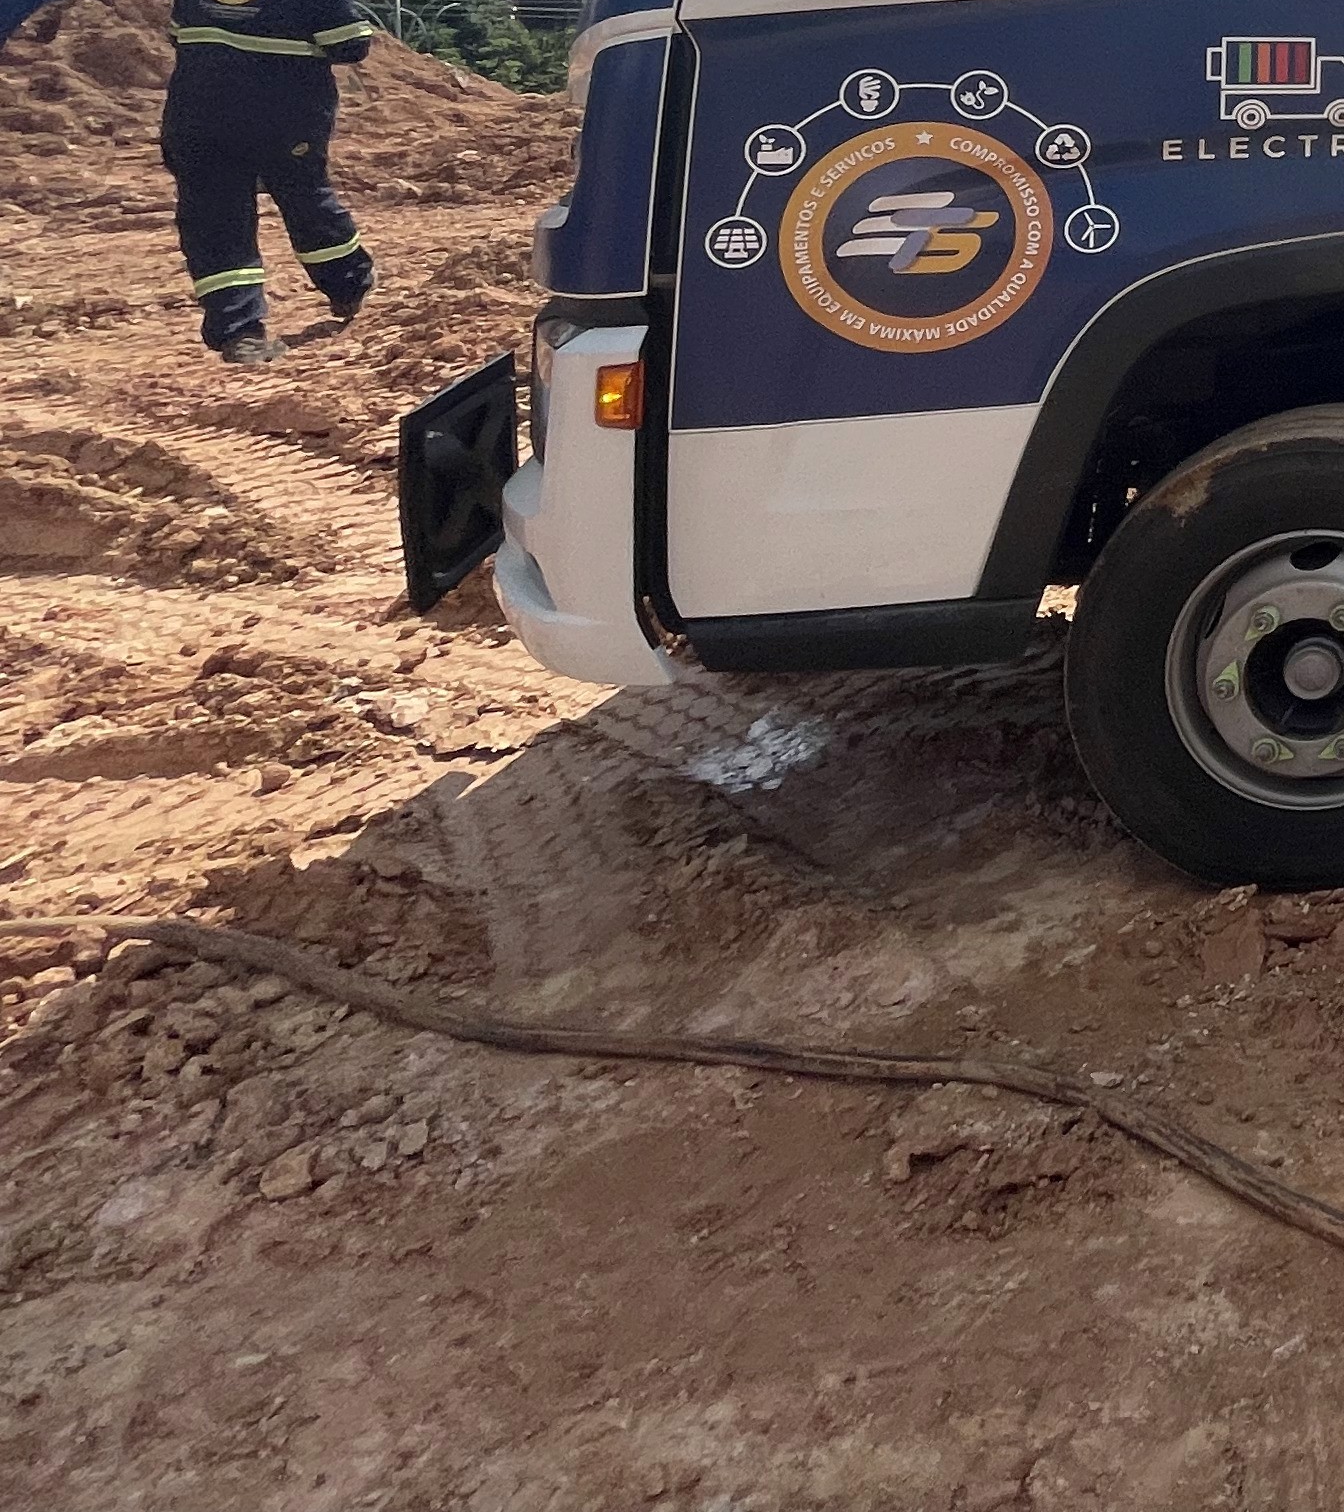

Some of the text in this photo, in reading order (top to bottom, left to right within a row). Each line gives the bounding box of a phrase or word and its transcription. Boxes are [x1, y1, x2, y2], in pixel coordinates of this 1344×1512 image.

[820, 137, 896, 188] SERVIÇOS
[950, 137, 1040, 217] COMPROMISSO
[811, 187, 825, 198] E
[793, 199, 842, 314] EQUIPAMENTOS
[1024, 220, 1042, 255] COM
[1019, 258, 1034, 269] A
[839, 309, 866, 330] EM
[947, 272, 1027, 337] QUALIDADE
